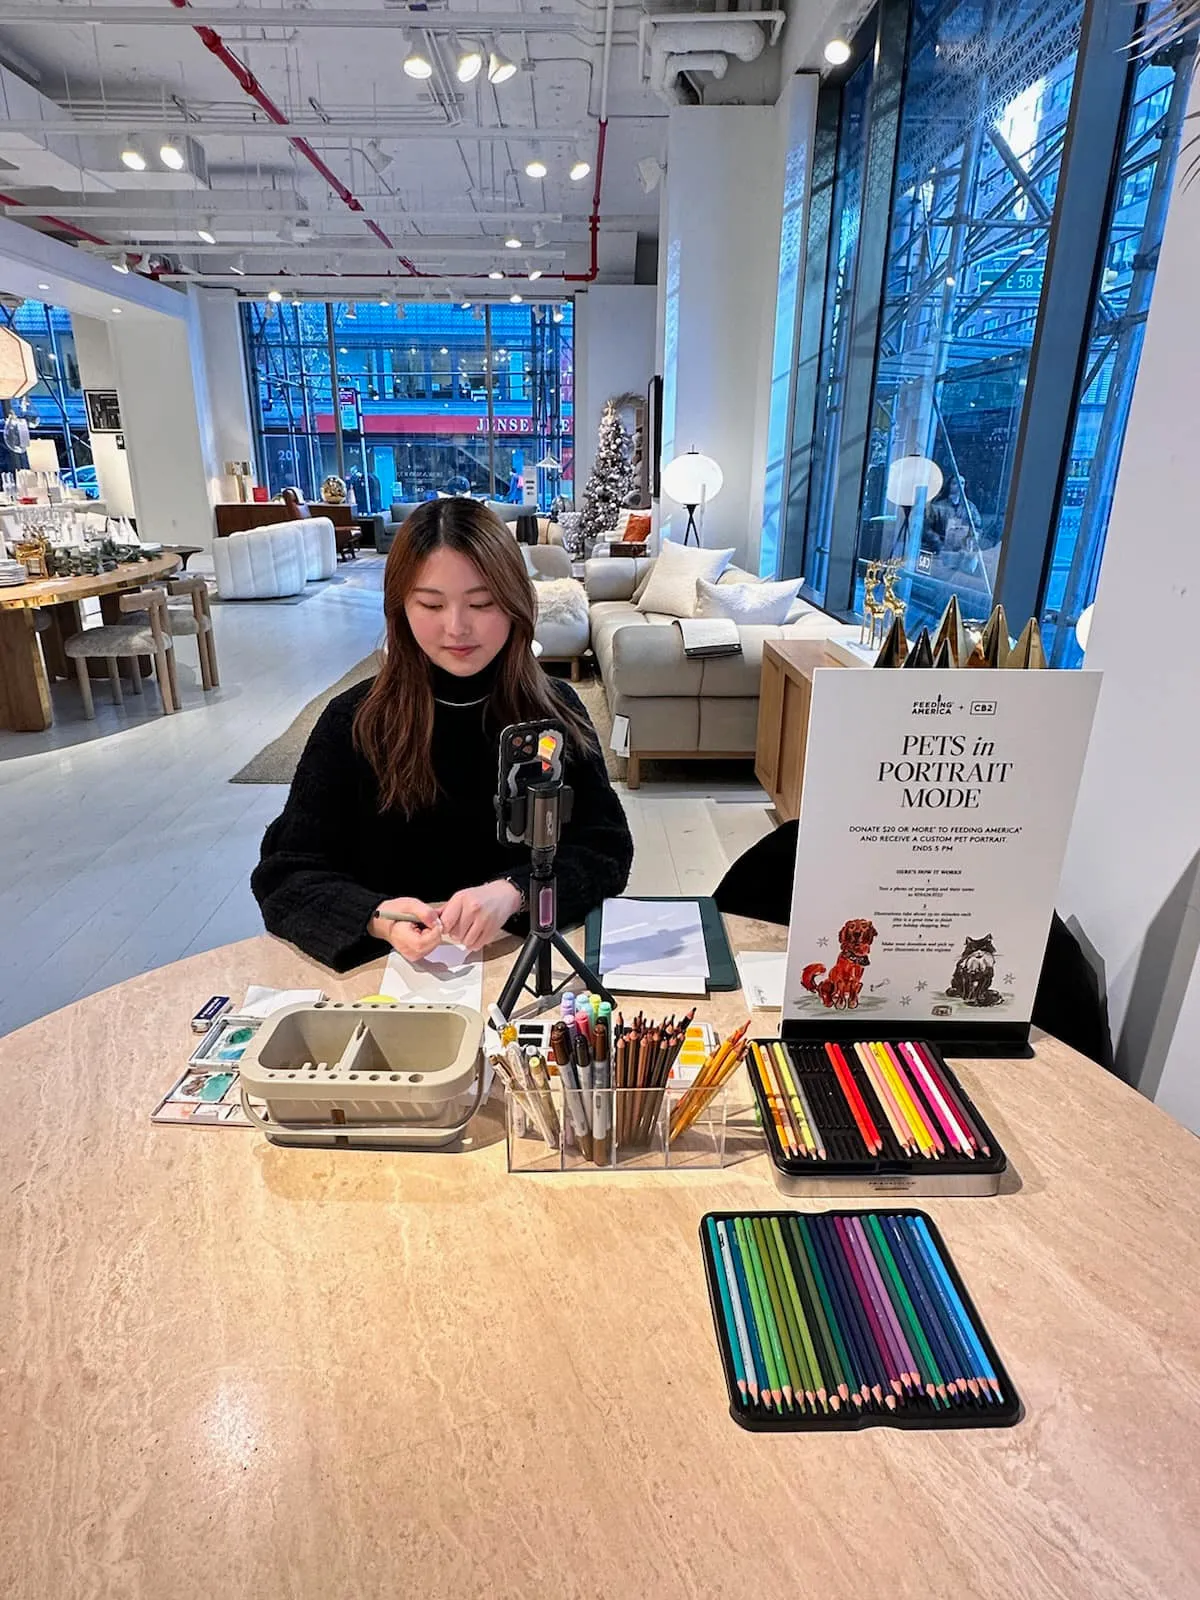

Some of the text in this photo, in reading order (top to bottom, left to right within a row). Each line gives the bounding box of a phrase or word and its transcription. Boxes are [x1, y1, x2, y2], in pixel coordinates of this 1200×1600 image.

[1006, 274, 1044, 288] E 58 S
[913, 696, 953, 708] FEEDING
[974, 704, 993, 712] CB2
[901, 735, 995, 756] PETS in
[877, 762, 1013, 783] PORTRAIT
[901, 788, 981, 809] MODE
